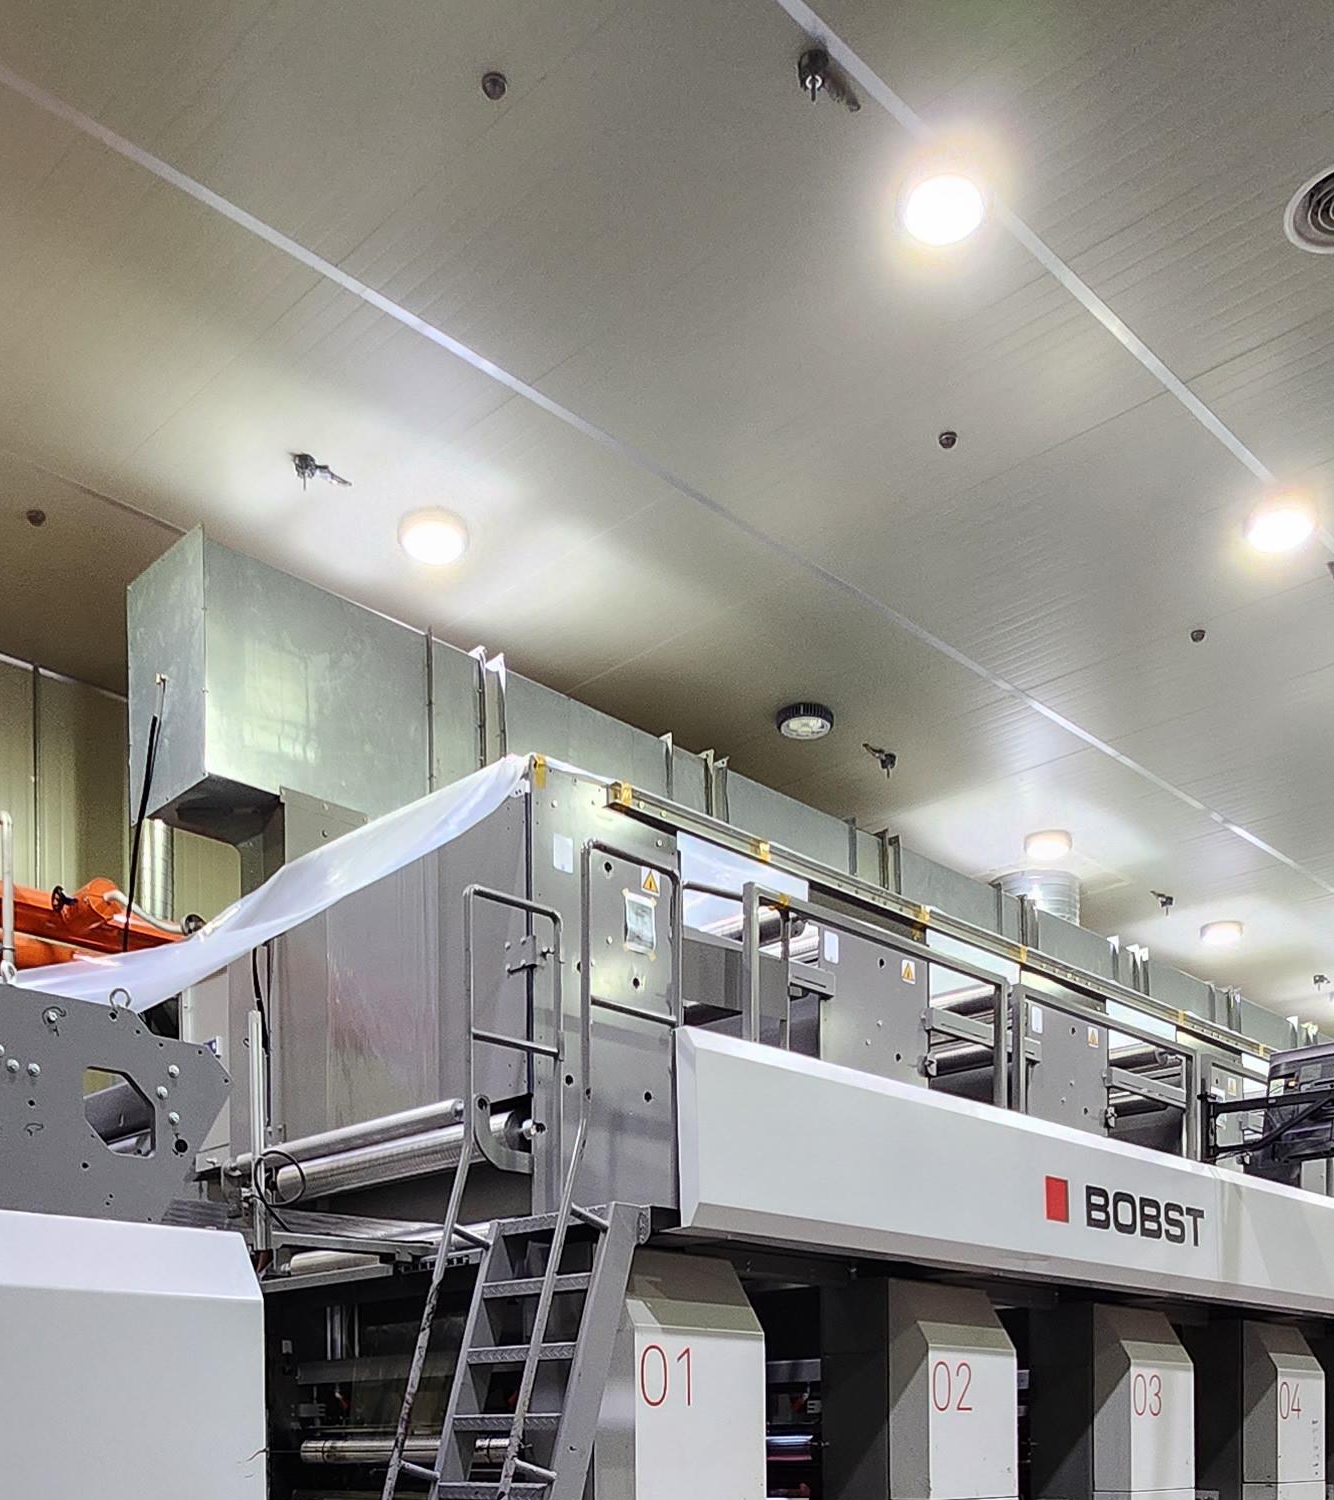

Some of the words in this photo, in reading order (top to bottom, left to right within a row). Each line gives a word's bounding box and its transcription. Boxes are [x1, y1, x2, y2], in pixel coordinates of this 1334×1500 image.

[1085, 1184, 1205, 1247] BOBST
[639, 1344, 695, 1408] 01
[932, 1360, 973, 1412] 02
[1133, 1372, 1163, 1417] 03
[1279, 1381, 1302, 1420] 04
